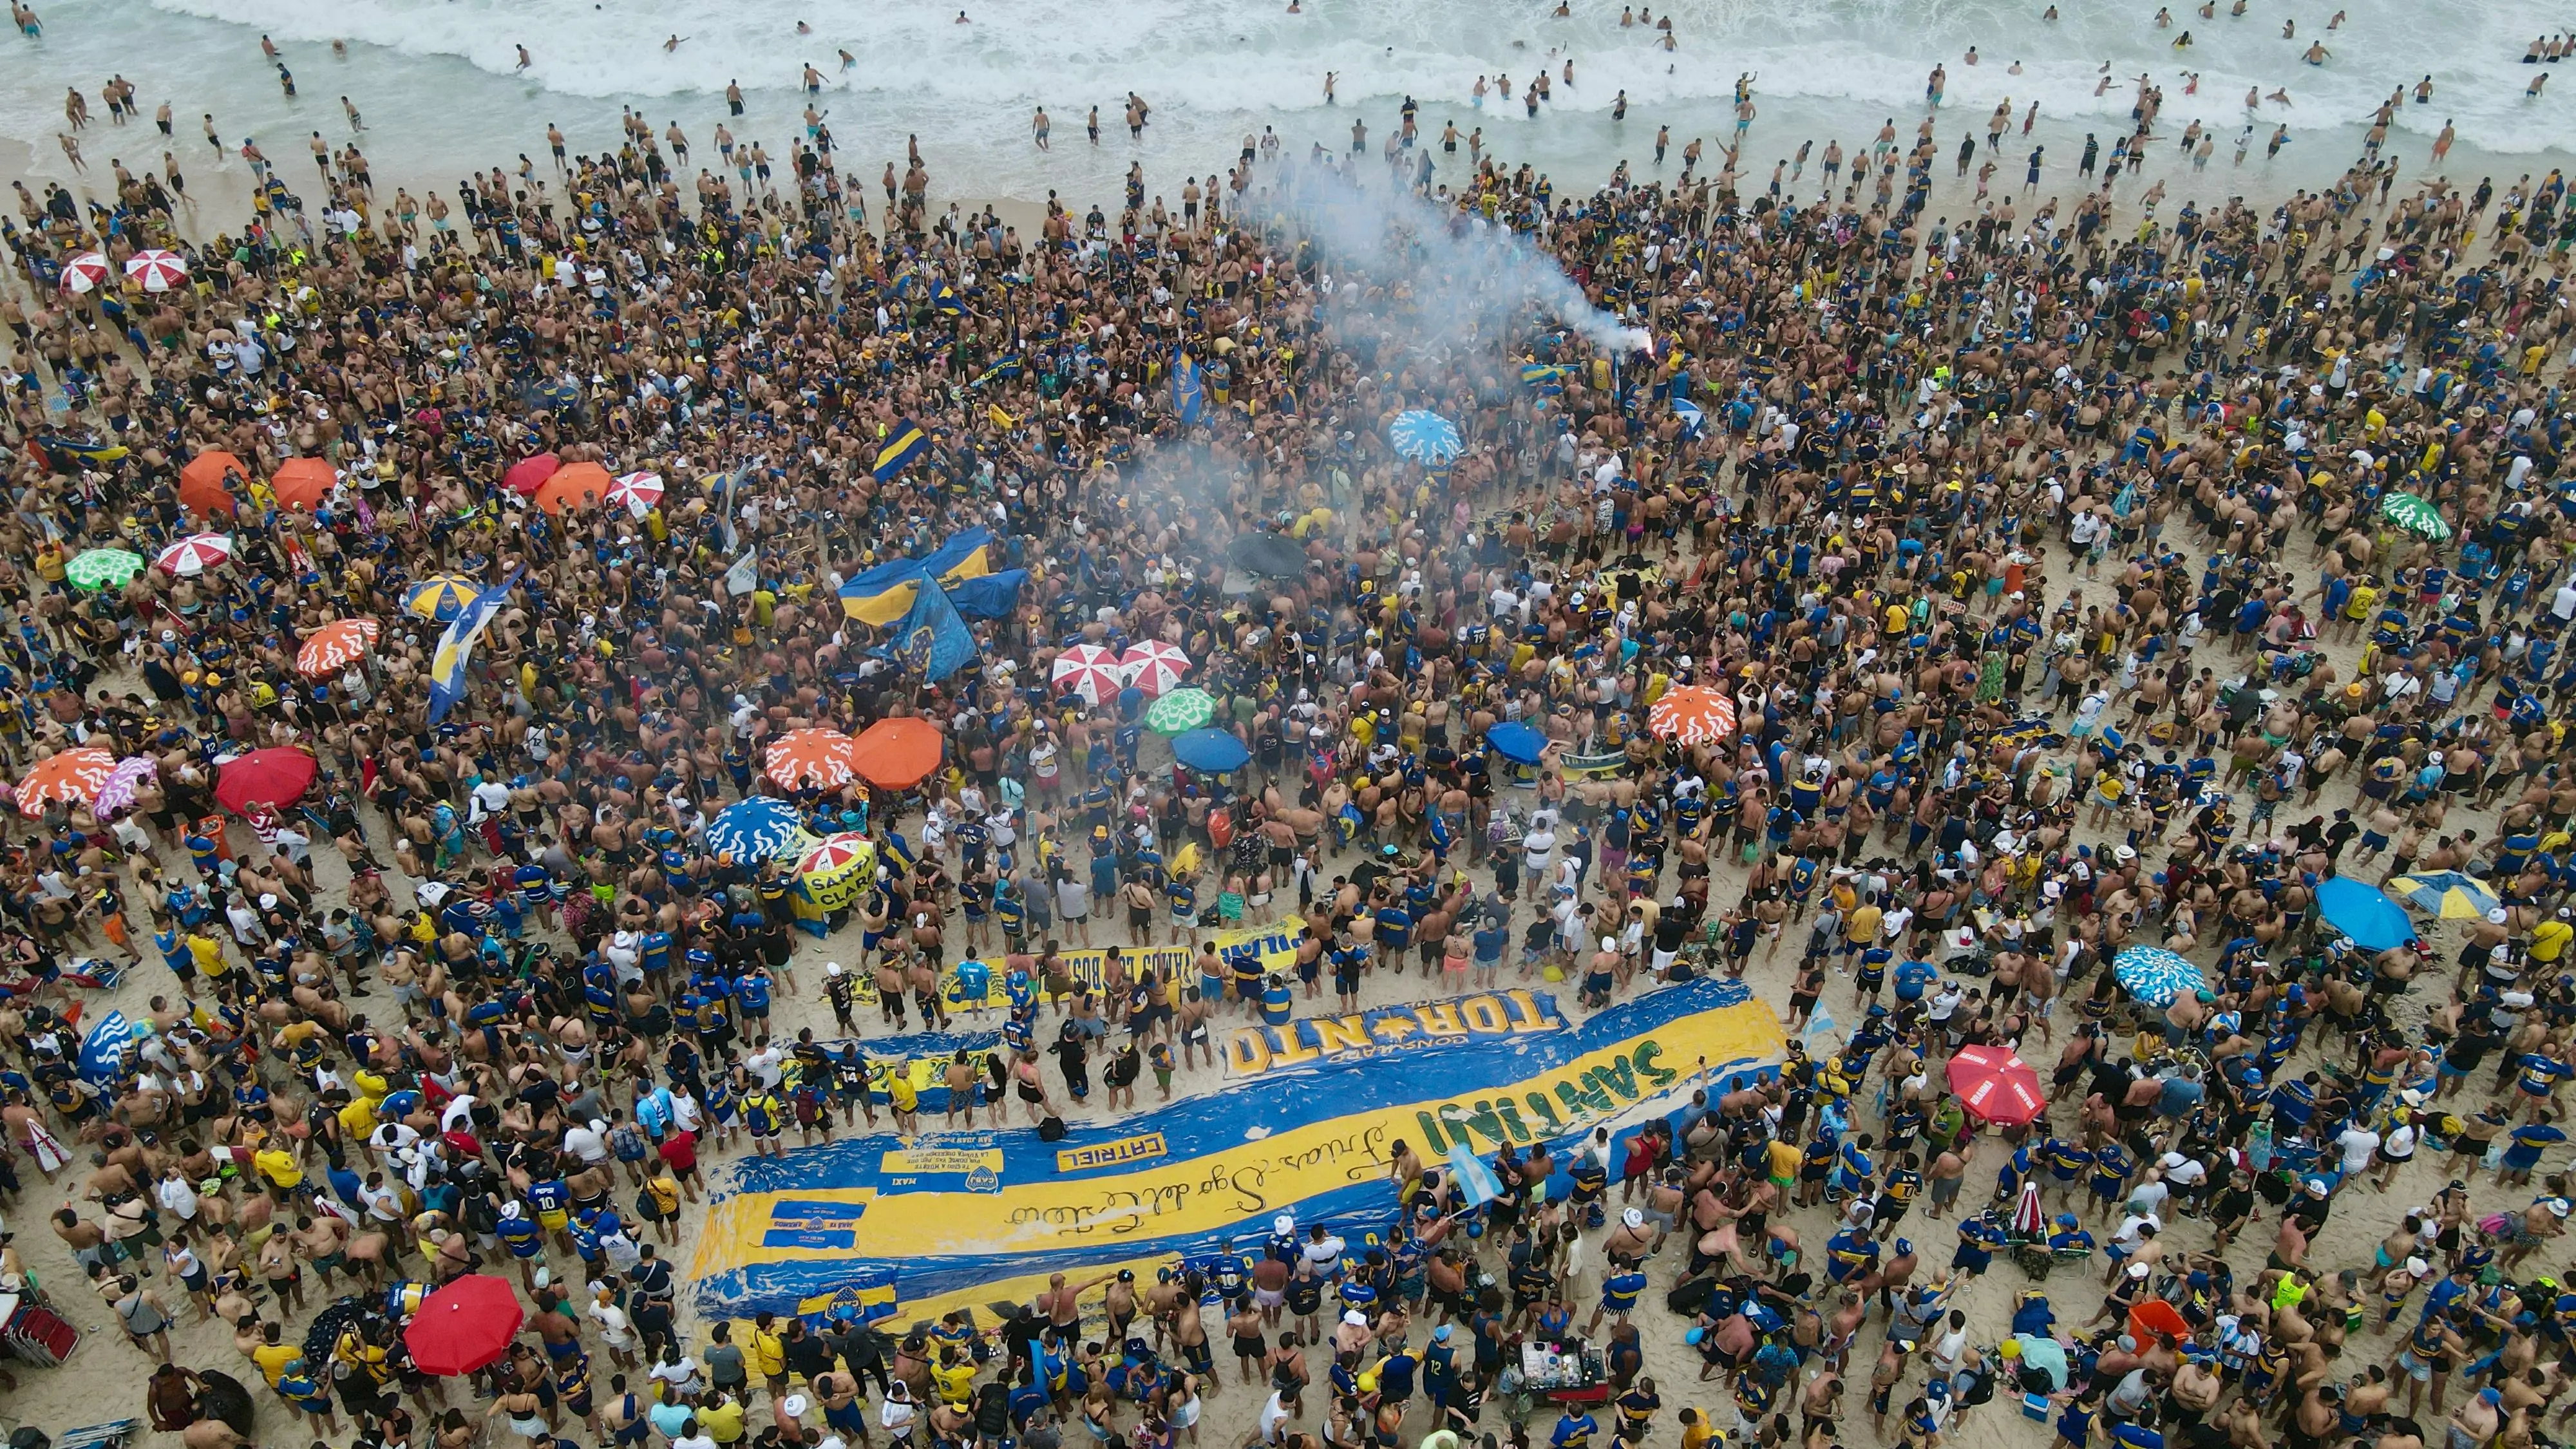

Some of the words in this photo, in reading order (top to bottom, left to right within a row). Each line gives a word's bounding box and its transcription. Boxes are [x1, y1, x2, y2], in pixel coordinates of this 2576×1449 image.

[1473, 632, 1486, 643] 19
[205, 742, 215, 754] 12
[2286, 762, 2296, 771] 12
[2075, 862, 2084, 871] 12
[1795, 869, 1808, 884] 12
[427, 884, 439, 893] 12
[820, 869, 875, 905] CLARA
[1327, 1035, 1470, 1063] CONSULADO
[1959, 1052, 1989, 1065] BRAHMA
[839, 1072, 859, 1083] 14
[1416, 1040, 1677, 1157] SANTINI
[1969, 1080, 1995, 1106] BRAHMA
[2013, 1082, 2036, 1110] BRAHMA
[1062, 1138, 1162, 1165] CATRIEL
[893, 1177, 917, 1186] MAXI
[1142, 1183, 1189, 1213] del
[1903, 1186, 1914, 1197] 10
[539, 1197, 555, 1210] 10
[1004, 1190, 1145, 1235] Estero
[1220, 1274, 1236, 1286] 10
[1431, 1359, 1441, 1375] 12
